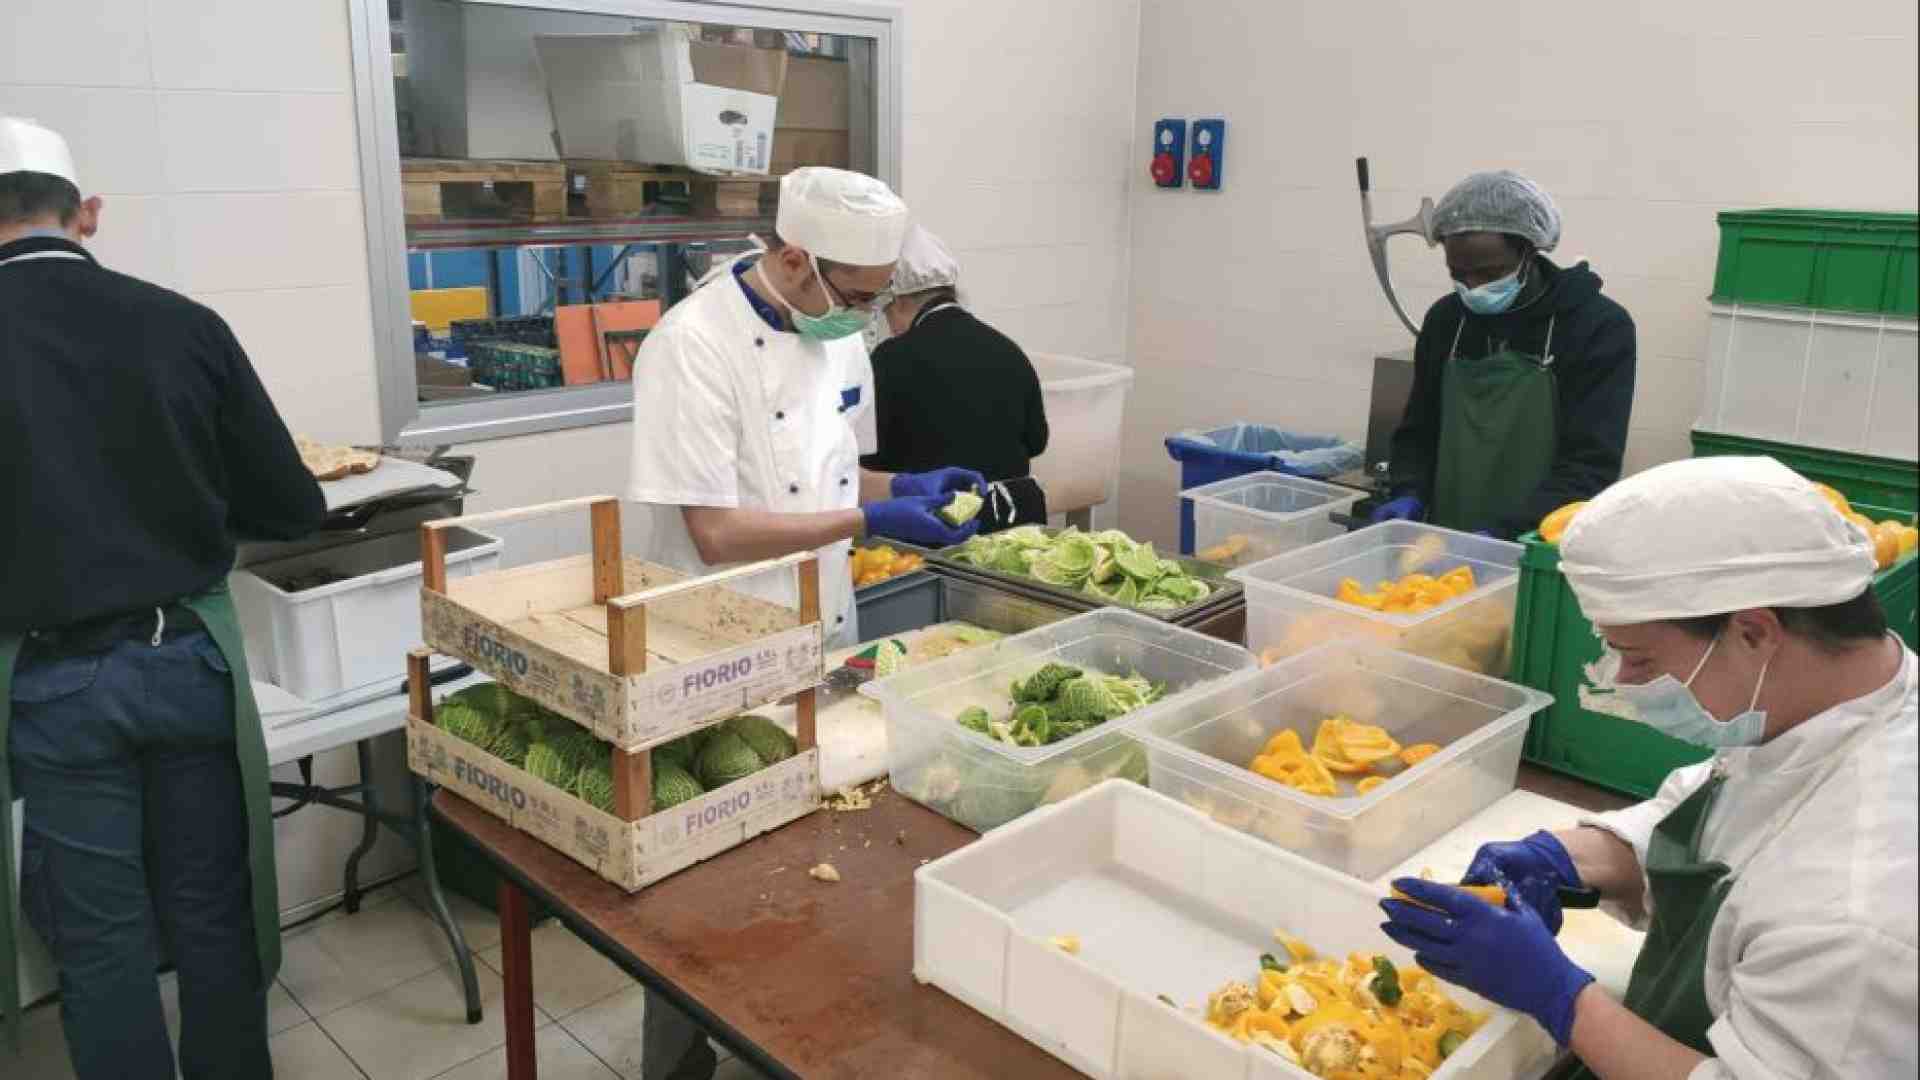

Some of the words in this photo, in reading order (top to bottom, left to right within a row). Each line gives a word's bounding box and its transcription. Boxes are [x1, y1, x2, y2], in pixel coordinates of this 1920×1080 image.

[683, 656, 752, 697] FIORIO
[453, 756, 526, 809] FIORIO
[686, 791, 750, 834] FIORIO
